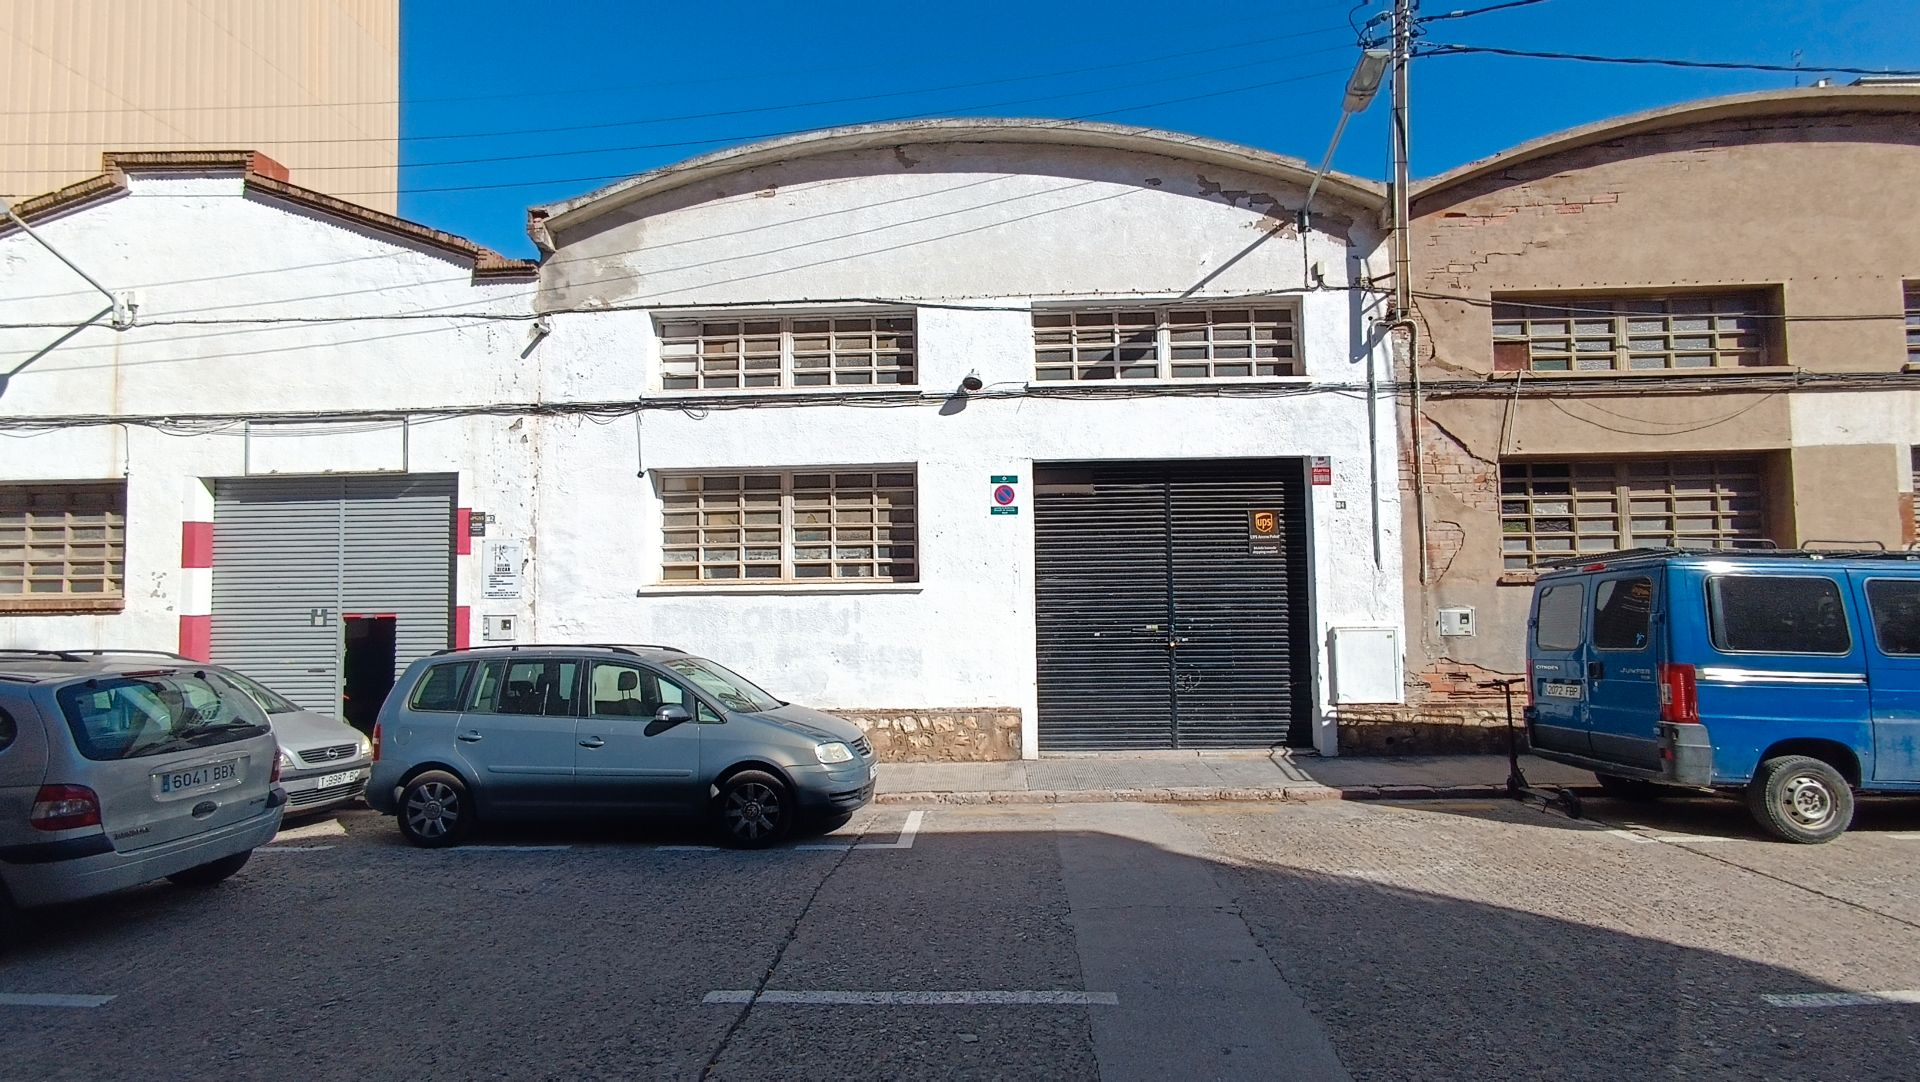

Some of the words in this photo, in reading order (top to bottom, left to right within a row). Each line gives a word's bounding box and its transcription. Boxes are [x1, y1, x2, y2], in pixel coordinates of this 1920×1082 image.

[1257, 518, 1272, 530] ups
[1547, 685, 1563, 695] 2072
[1565, 686, 1578, 696] FBP
[173, 769, 208, 789] 6041
[213, 764, 236, 781] BBX
